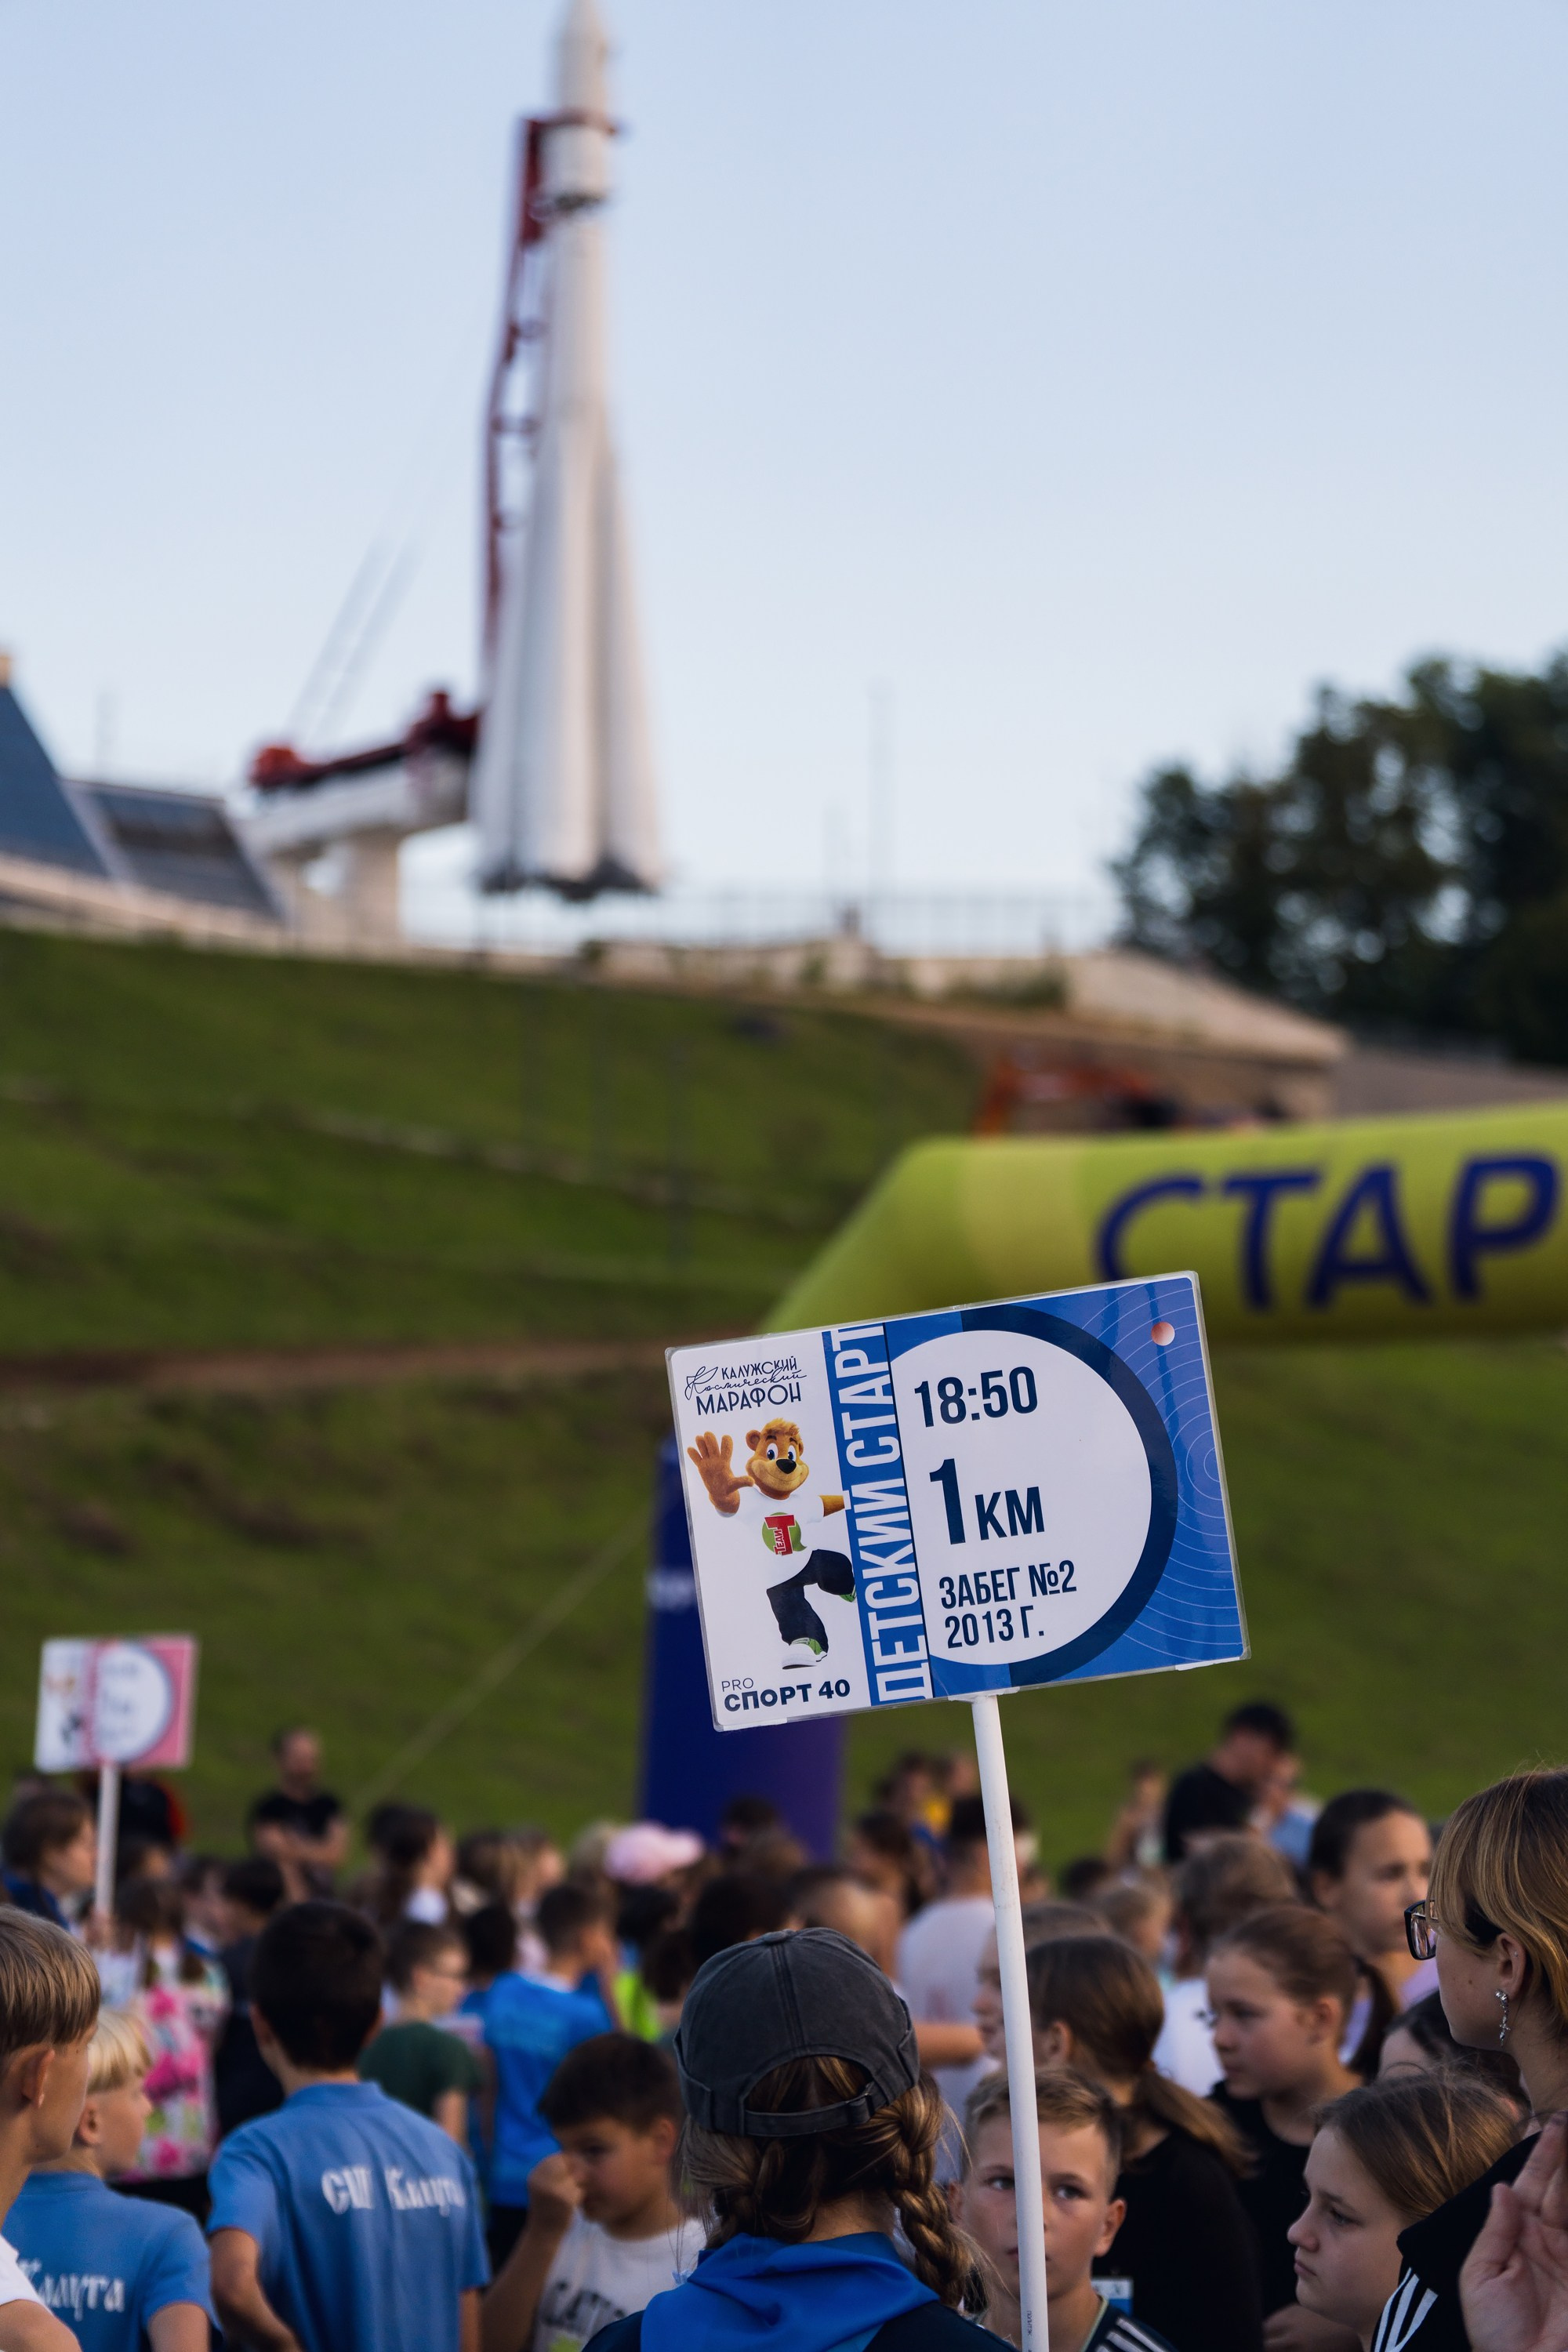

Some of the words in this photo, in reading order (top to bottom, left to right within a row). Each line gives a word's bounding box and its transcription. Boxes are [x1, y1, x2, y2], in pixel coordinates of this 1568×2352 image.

[721, 1356, 797, 1380] КАЛУЖСКИЙ
[695, 1382, 801, 1415] МАРАФОН
[830, 1326, 902, 1468] СТАРТ
[914, 1367, 1038, 1428] 18:50
[929, 1458, 966, 1545] 1
[975, 1486, 1045, 1541] КМ
[843, 1478, 934, 1702] ДЕТСКИЙ
[939, 1567, 1020, 1609] ЗАБЕГ
[1028, 1560, 1077, 1597] №2
[945, 1609, 1014, 1649] 2013
[1020, 1606, 1044, 1639] Г.
[721, 1678, 754, 1692] PRO
[724, 1683, 812, 1711] СПОРТ
[818, 1679, 851, 1699] 40
